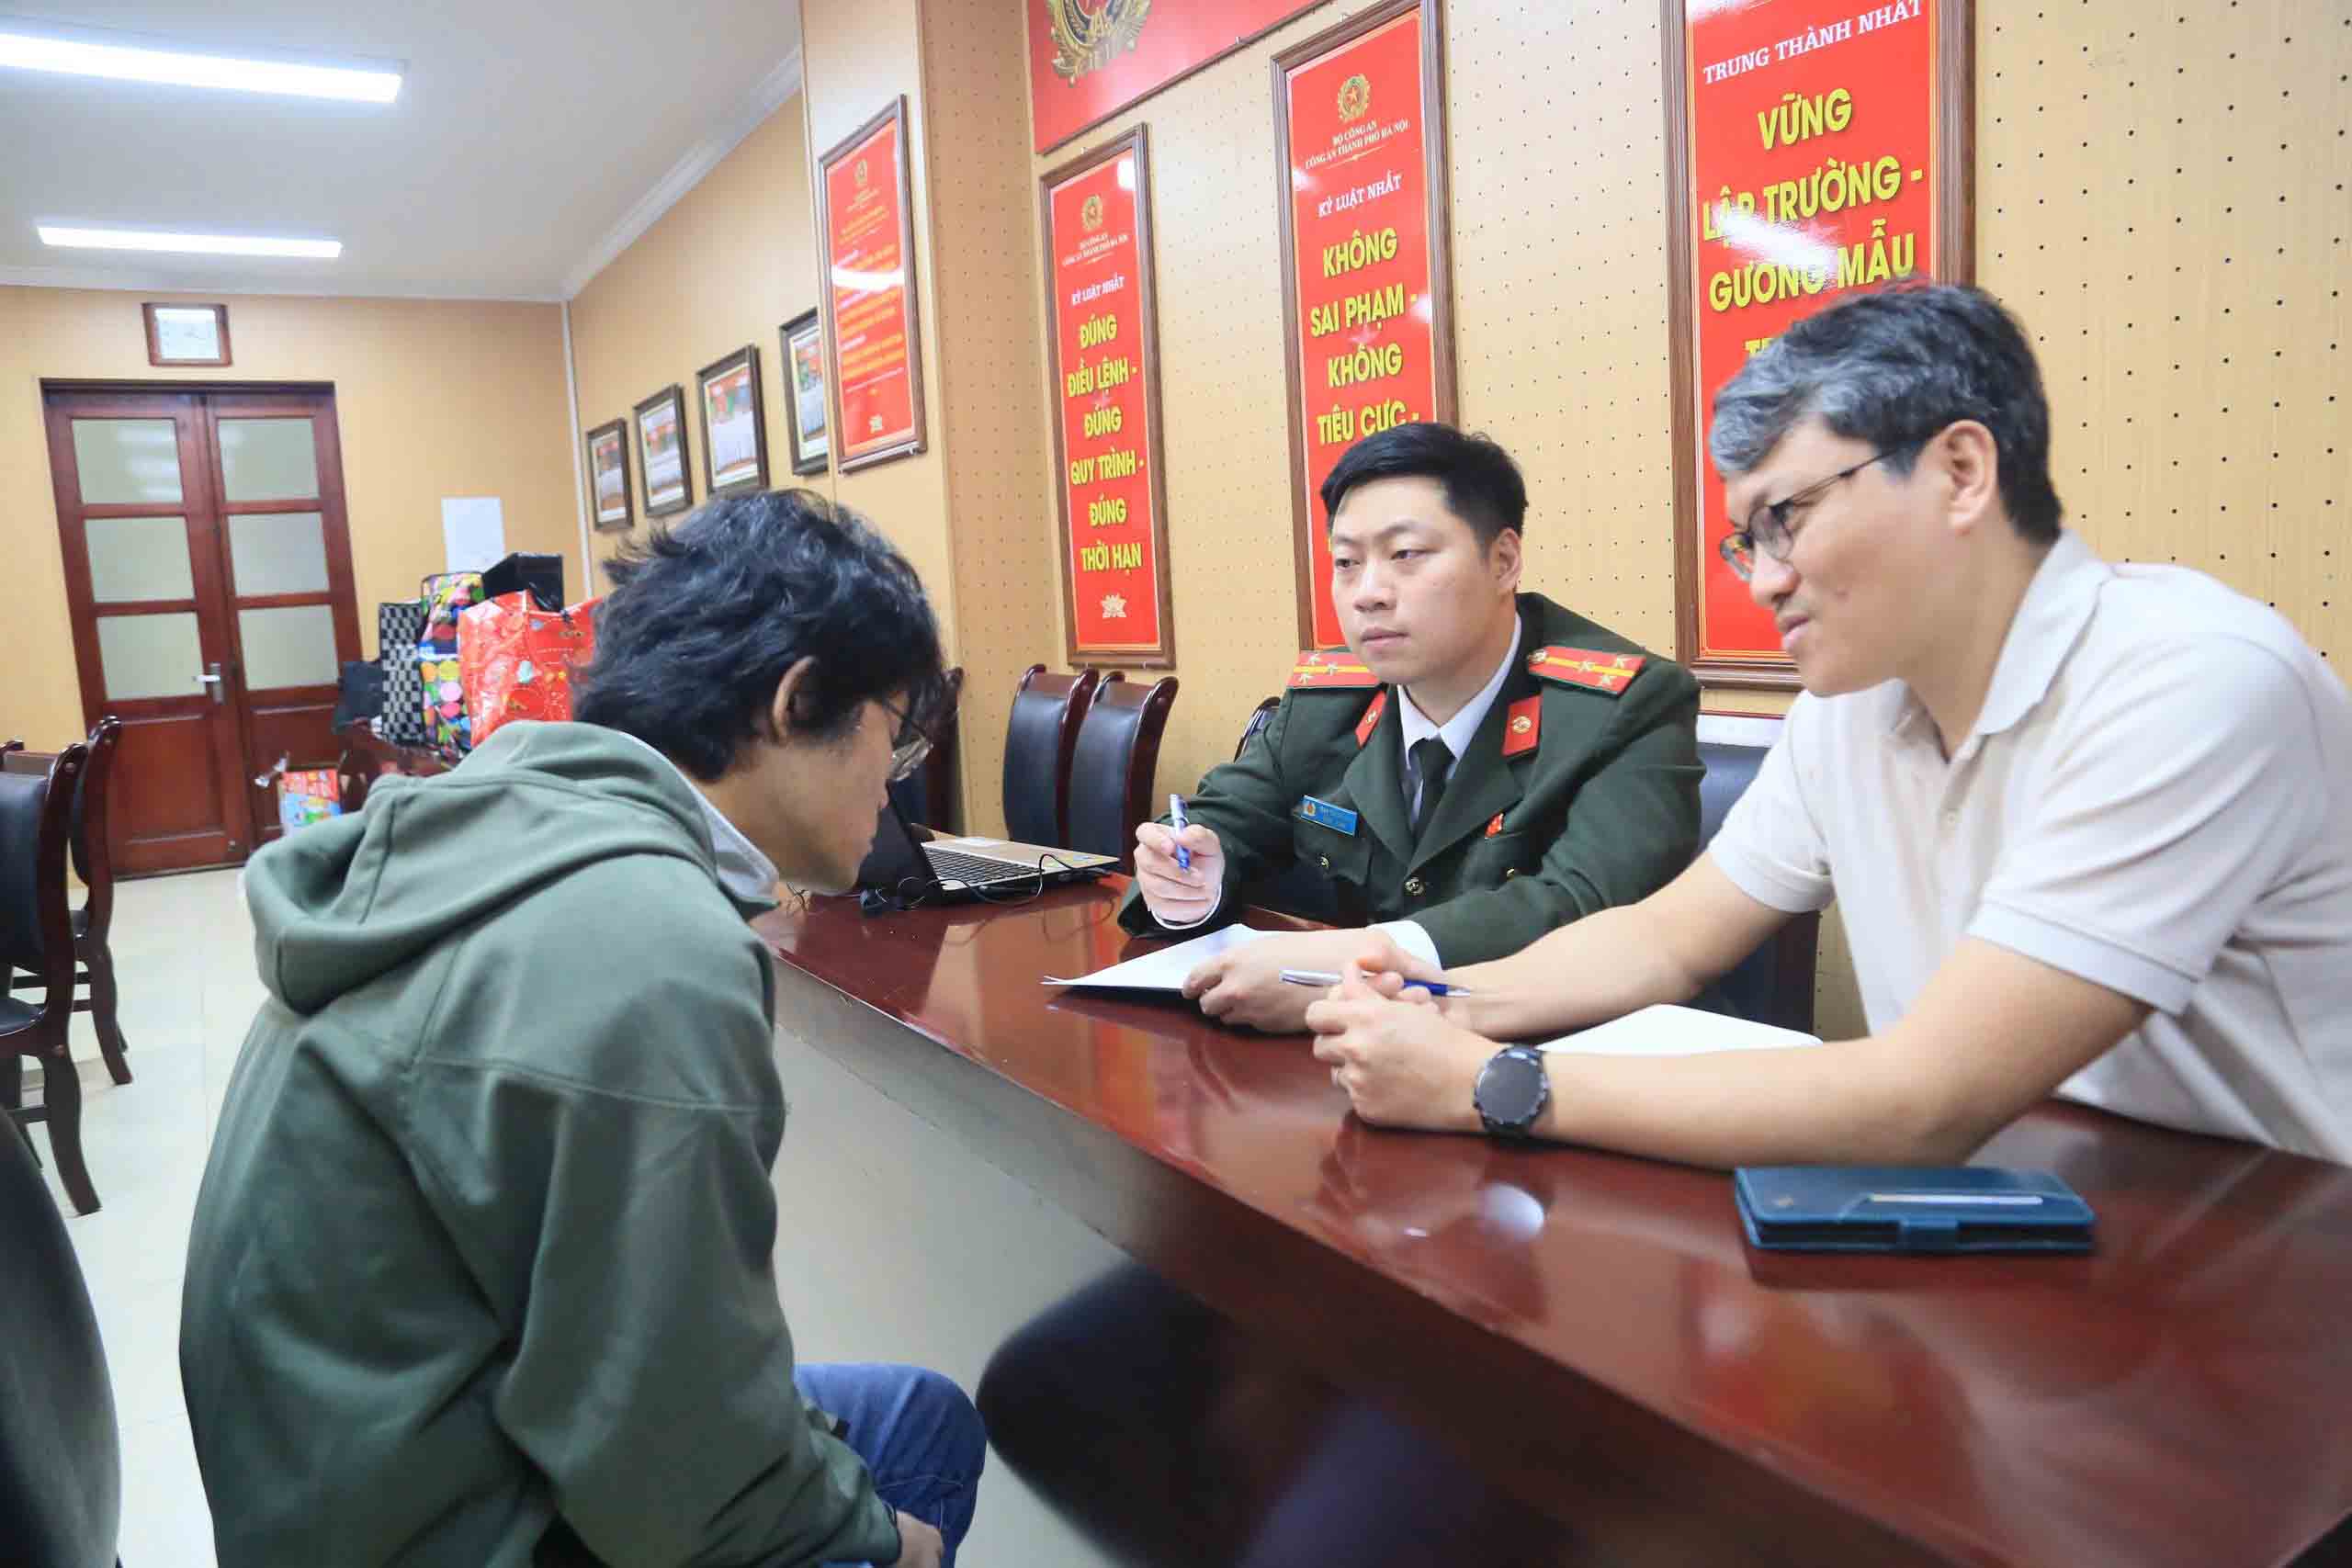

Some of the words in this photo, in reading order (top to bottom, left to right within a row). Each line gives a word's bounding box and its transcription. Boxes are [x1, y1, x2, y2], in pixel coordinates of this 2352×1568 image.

[1703, 47, 1770, 85] TRUNG
[1775, 26, 1852, 62] THÀNH
[1758, 88, 1852, 150] VỮNG
[1336, 186, 1366, 211] LUẬT
[1367, 169, 1403, 199] NHẤT
[1764, 155, 1902, 225] TRƯỜNG
[1323, 227, 1397, 278] KHÔNG
[1837, 219, 1916, 289] MẪU
[1080, 312, 1117, 349] ĐÚNG
[1310, 300, 1340, 338] SAI
[1344, 282, 1405, 331] PHẠM
[1067, 356, 1094, 397] ĐIỀU
[1097, 355, 1129, 396] LỆNH
[1328, 343, 1402, 388] KHÔNG
[1083, 404, 1122, 439] ĐÚNG
[1317, 403, 1354, 446] TIÊU
[1071, 457, 1095, 485] QUY
[1097, 446, 1136, 480] TRÌNH
[1089, 493, 1127, 526] ĐÚNG
[1080, 538, 1110, 572] THỜI
[1112, 542, 1142, 576] HẠN
